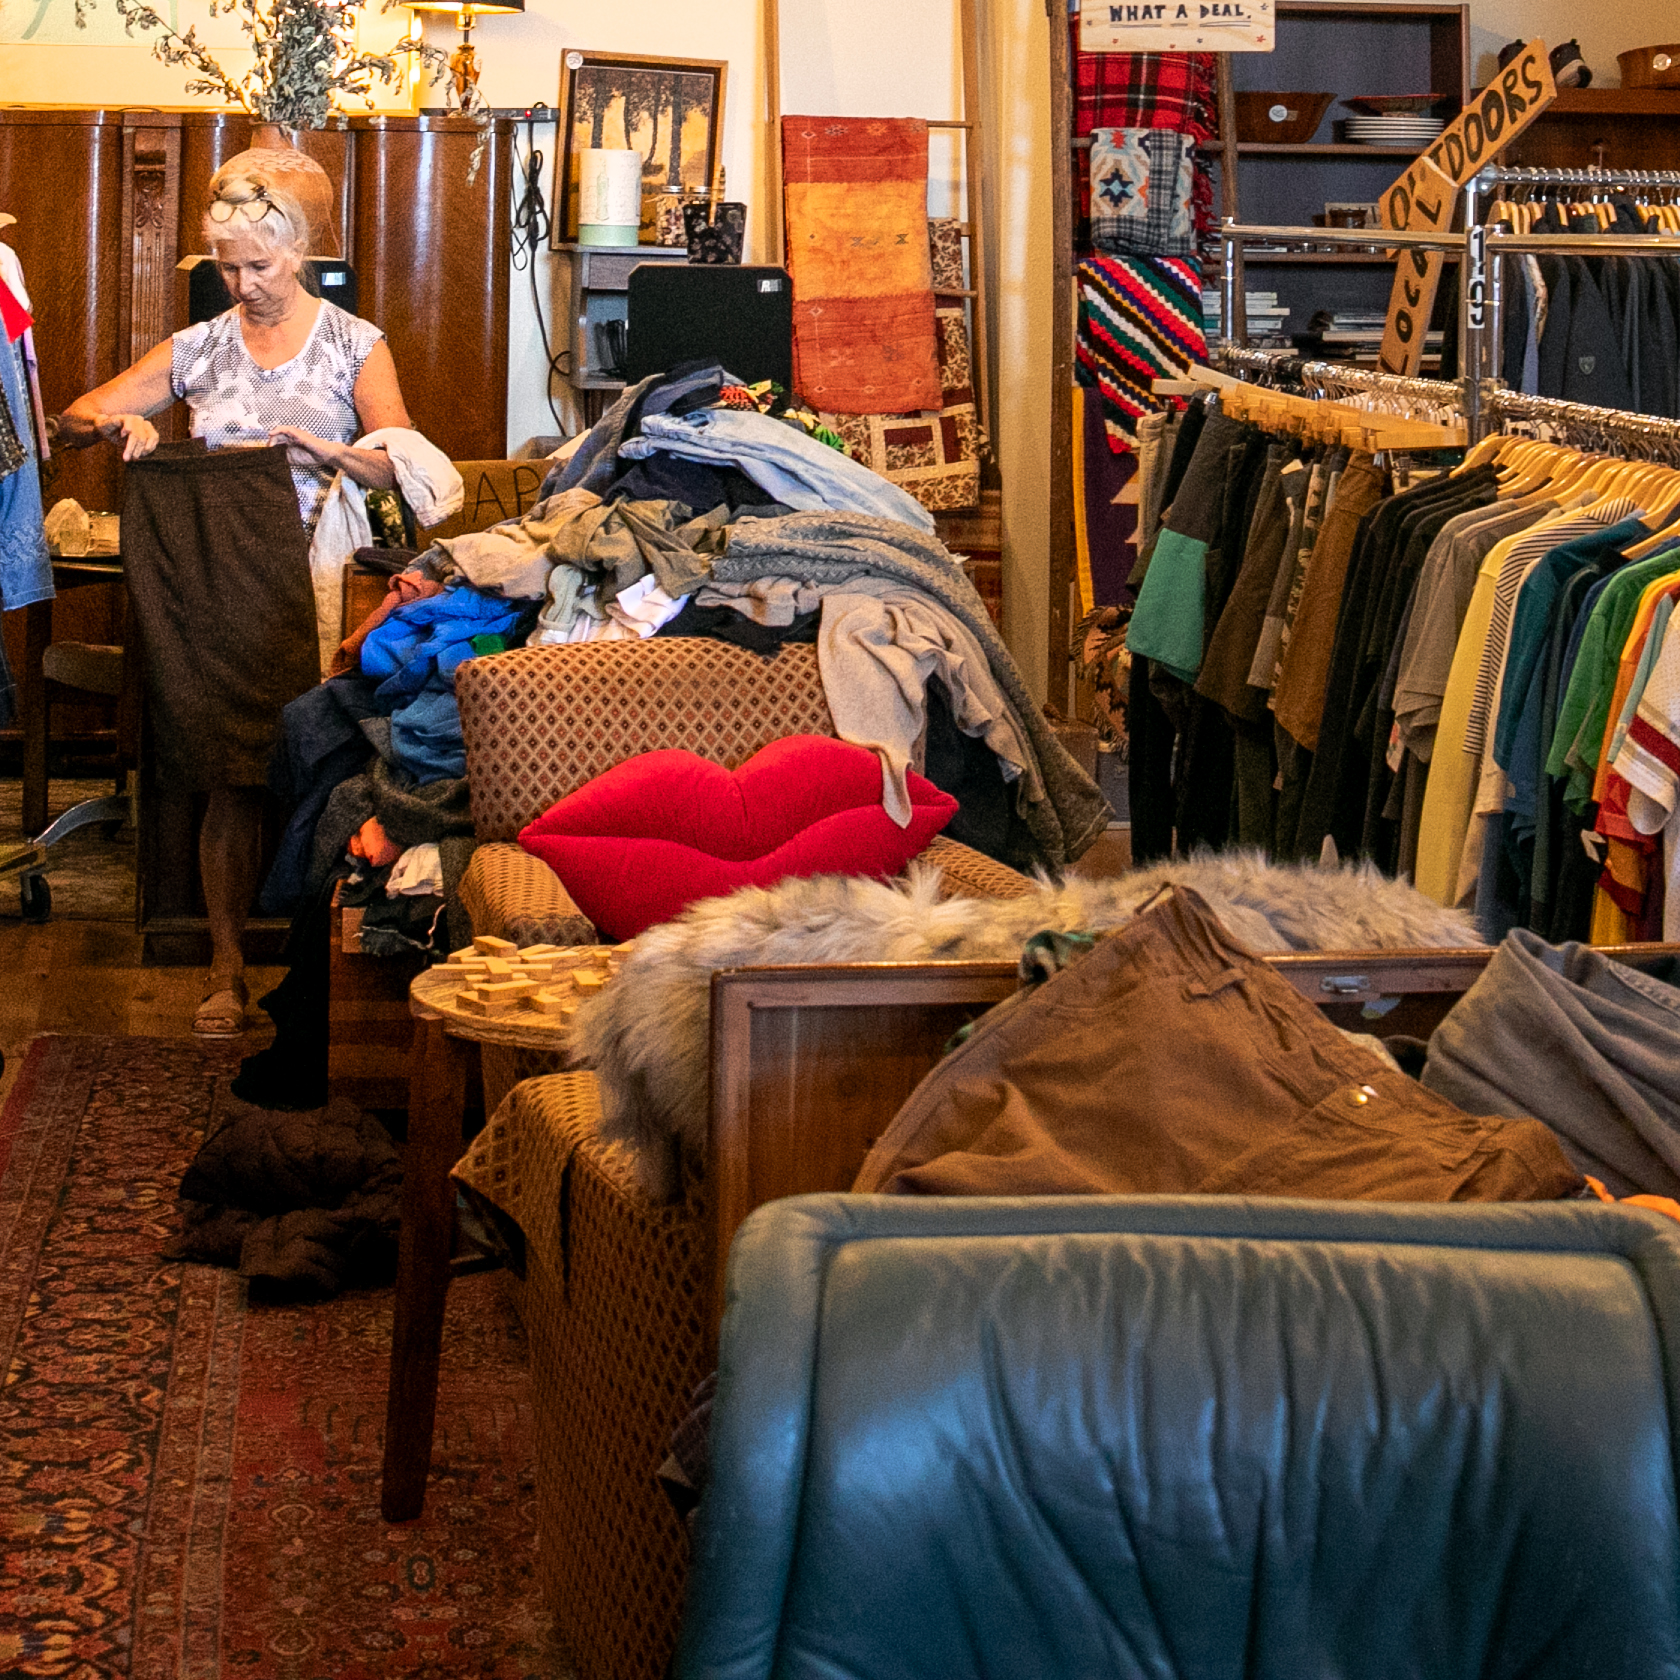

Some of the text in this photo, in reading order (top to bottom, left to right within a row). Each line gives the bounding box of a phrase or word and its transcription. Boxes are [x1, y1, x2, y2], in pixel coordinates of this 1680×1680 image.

[1109, 3, 1253, 22] WHAT A DEAL.
